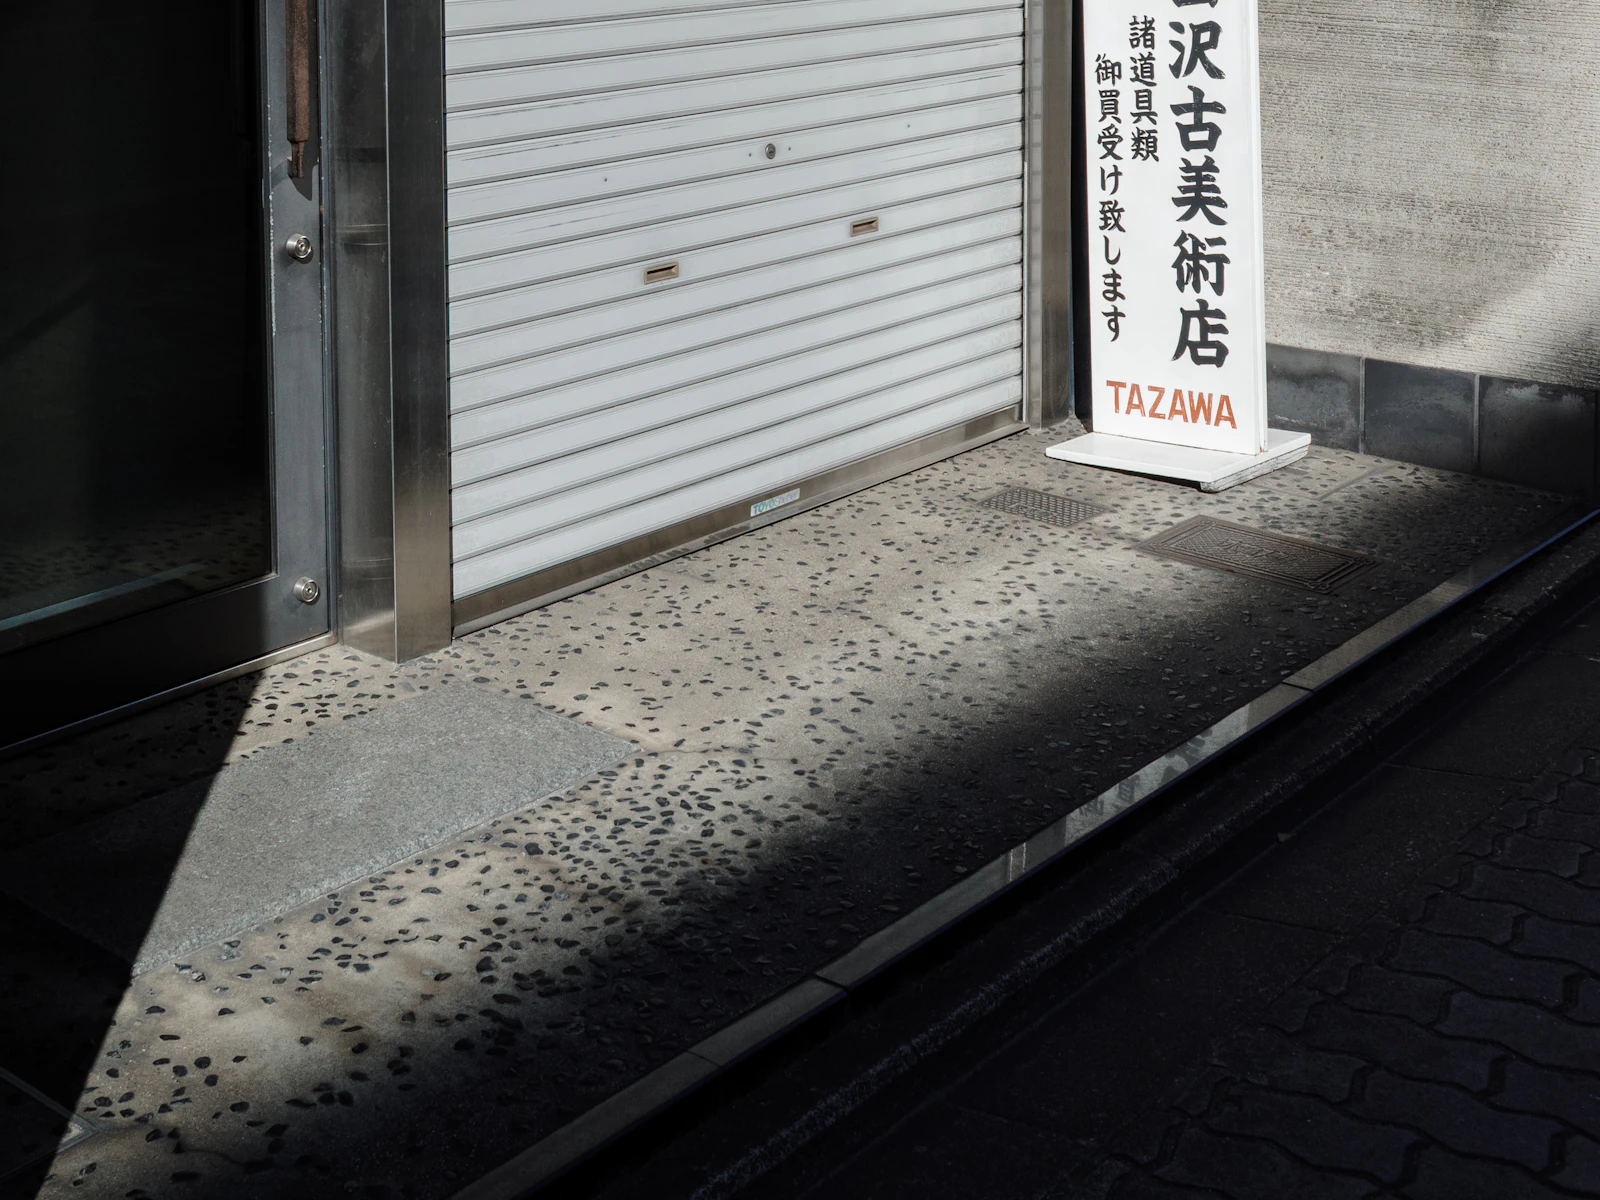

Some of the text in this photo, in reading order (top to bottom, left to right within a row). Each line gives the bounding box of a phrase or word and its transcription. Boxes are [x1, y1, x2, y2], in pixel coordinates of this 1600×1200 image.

[1128, 15, 1160, 162] 諸道具類
[1094, 53, 1127, 342] 御買受け致します
[1106, 380, 1237, 429] TAZAWA
